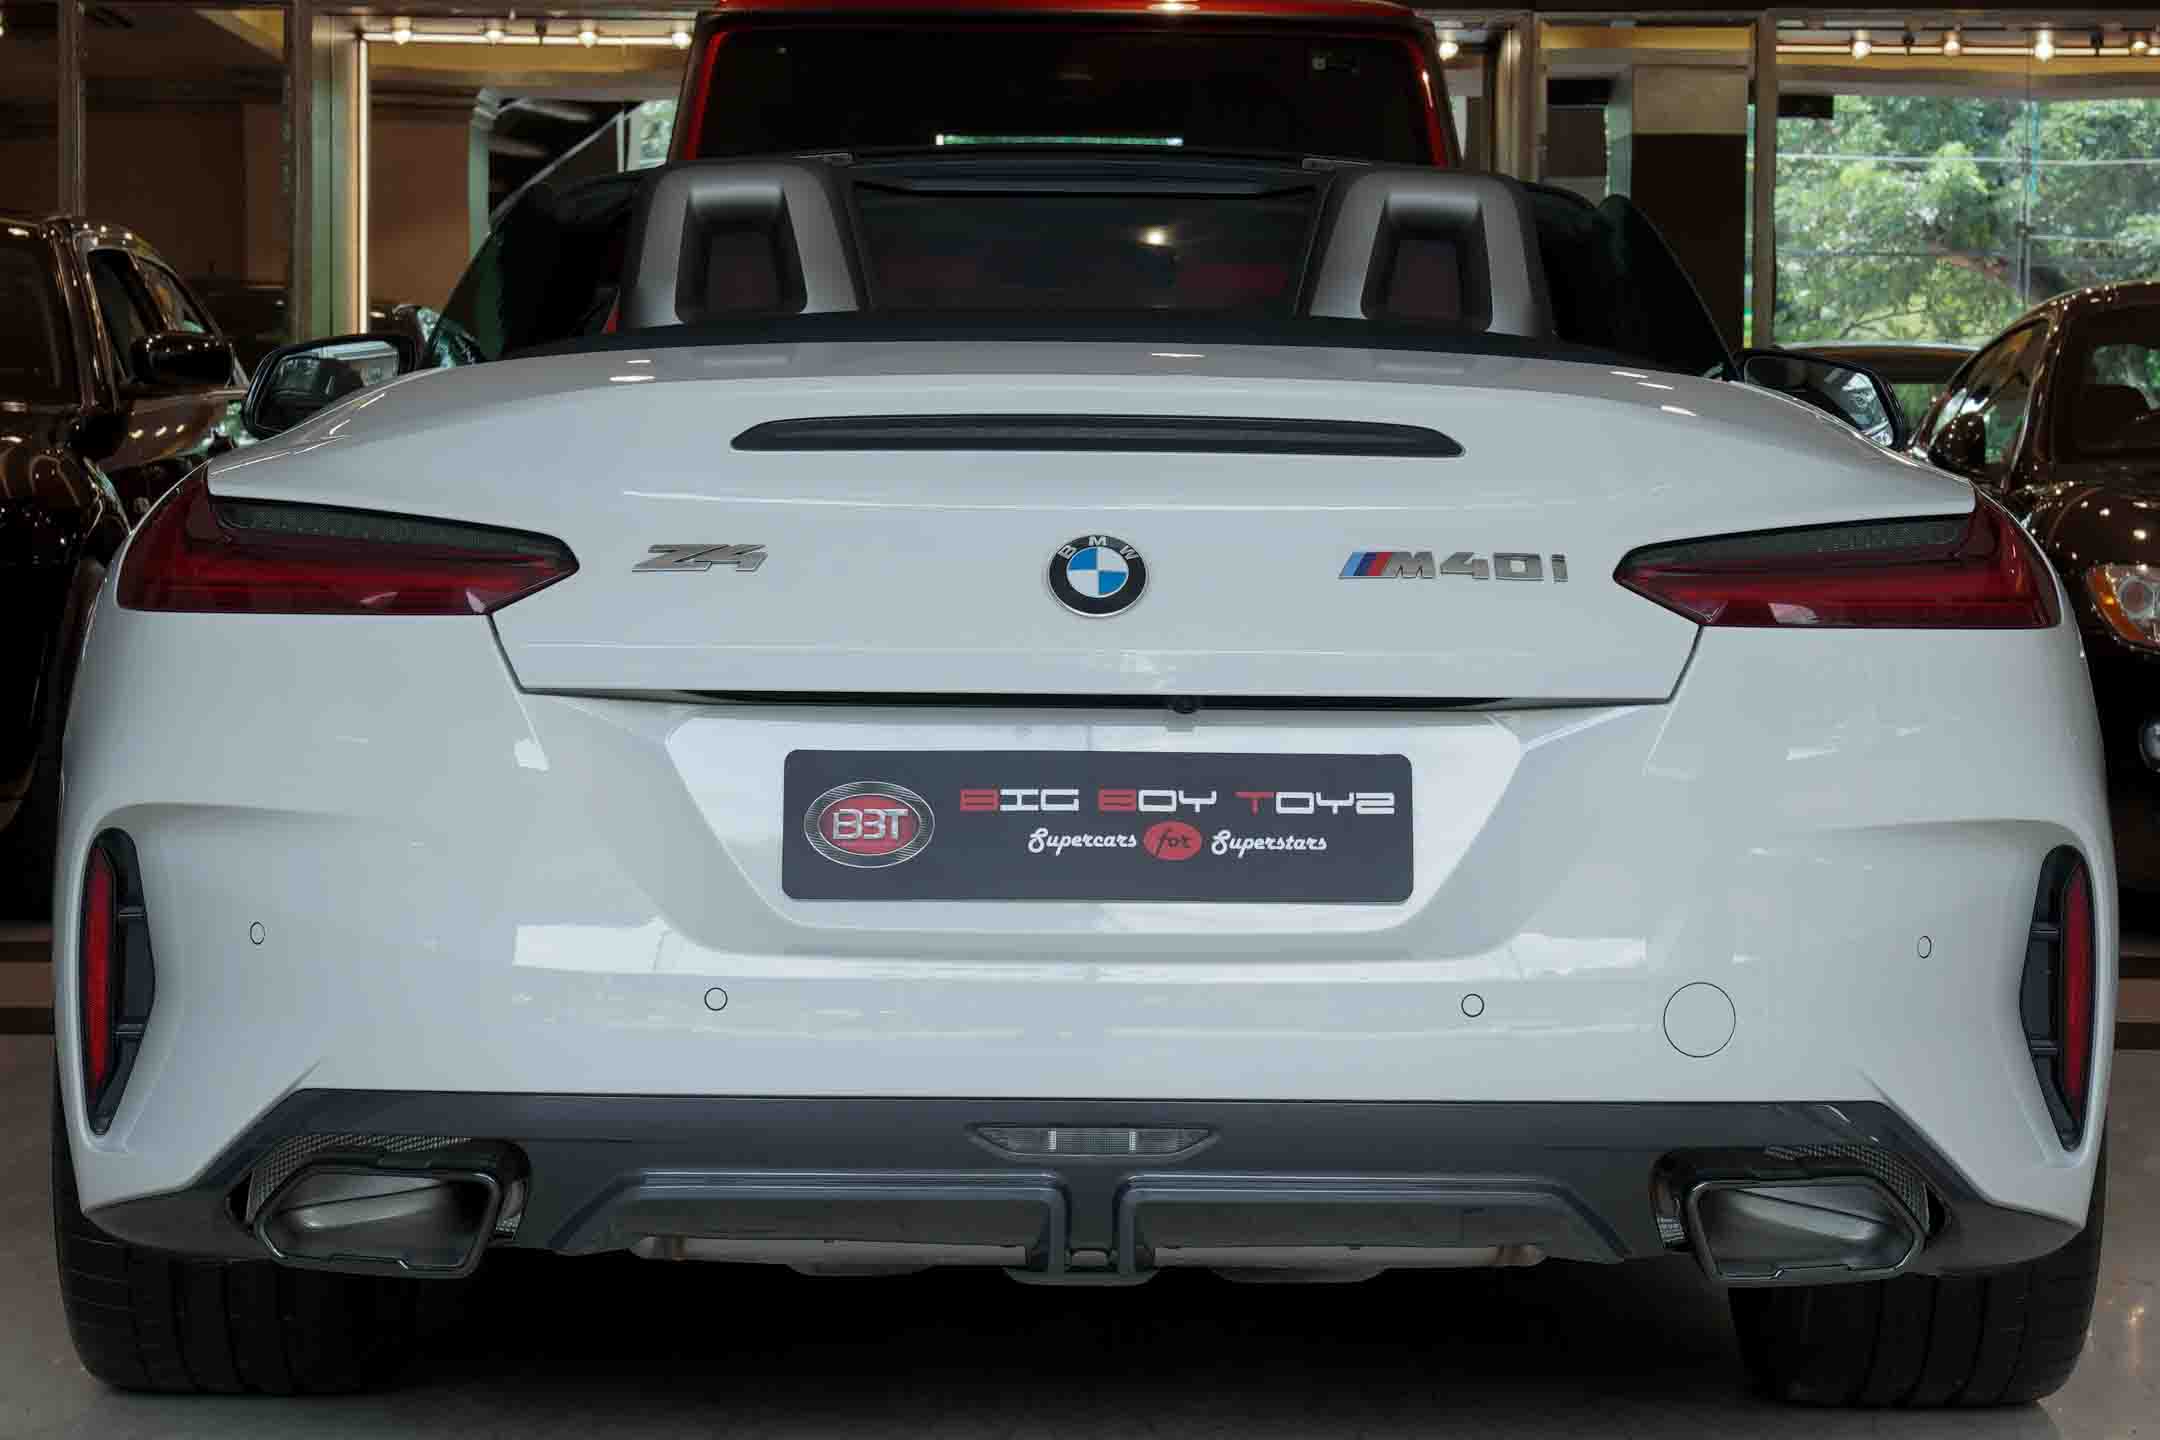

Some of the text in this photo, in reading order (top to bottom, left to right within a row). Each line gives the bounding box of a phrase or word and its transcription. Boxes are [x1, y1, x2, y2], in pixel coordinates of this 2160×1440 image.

[632, 544, 768, 573] Z4
[1058, 536, 1139, 560] BMW
[1350, 551, 1569, 583] M40i
[960, 789, 1395, 815] BIG BOY TOYZ
[1027, 827, 1328, 859] Supercars for Superstars
